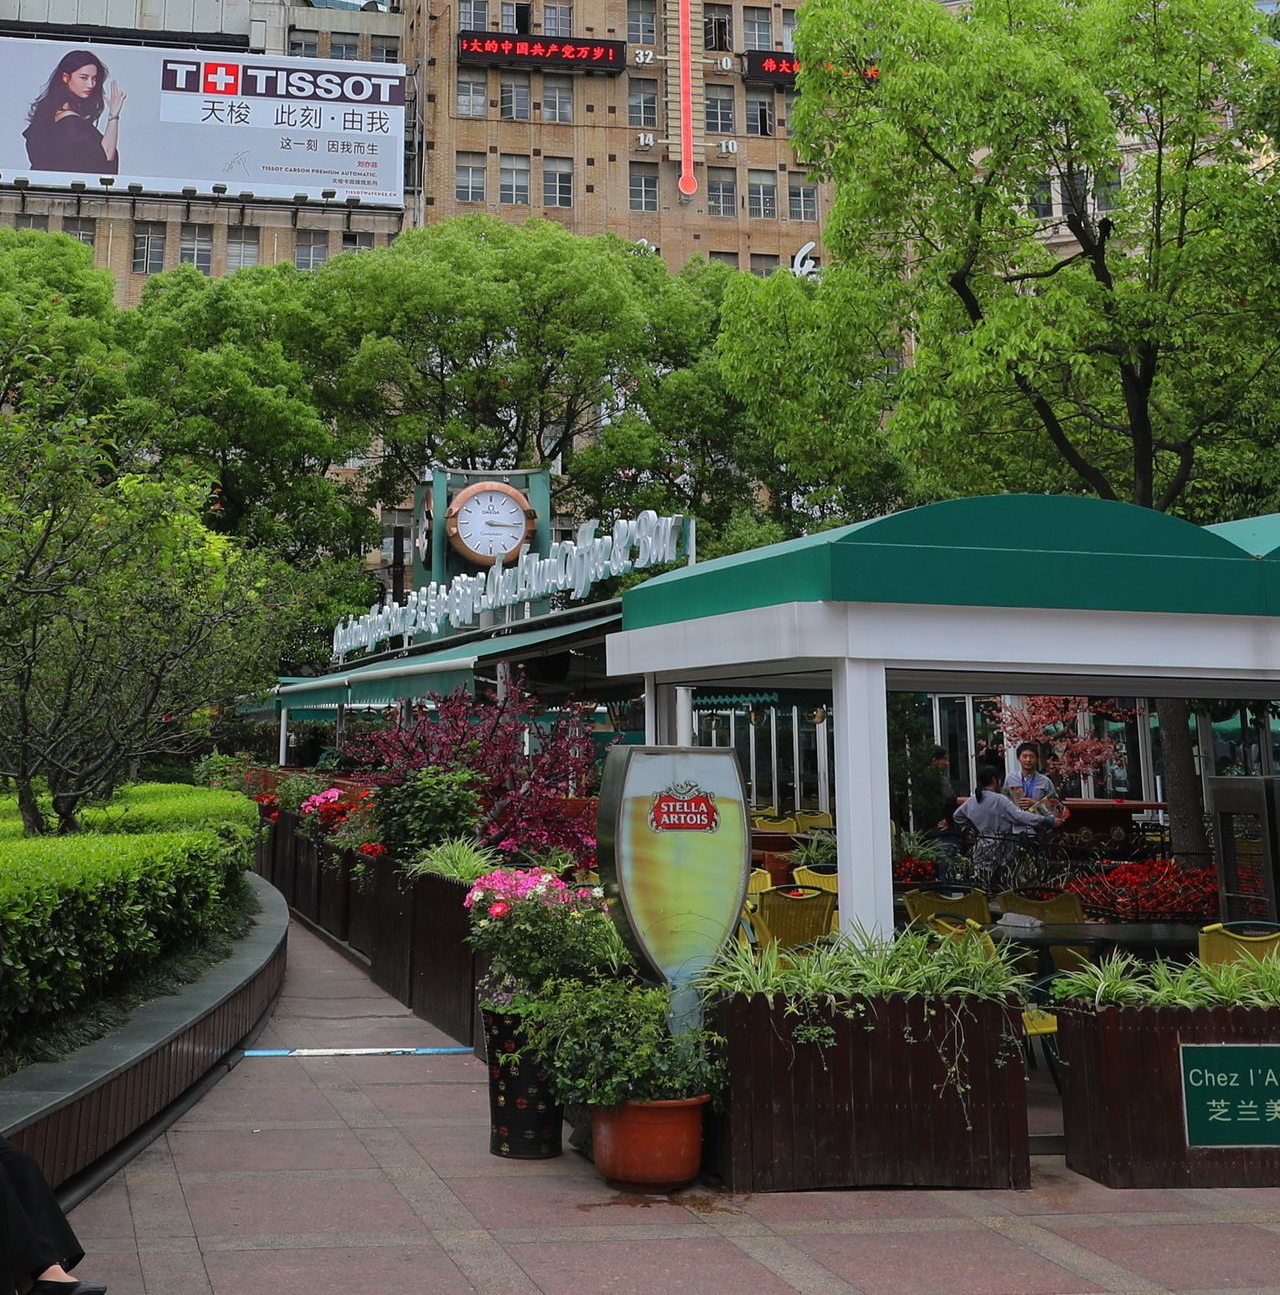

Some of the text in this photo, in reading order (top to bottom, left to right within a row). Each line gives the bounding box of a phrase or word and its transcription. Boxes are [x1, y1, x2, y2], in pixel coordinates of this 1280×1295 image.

[635, 50, 654, 64] 32
[247, 69, 400, 102] TISSOT
[201, 100, 251, 125] 天梭
[280, 137, 379, 155] 这一刻 因我而生
[637, 133, 654, 147] 14
[633, 510, 683, 569] Bar
[661, 802, 707, 812] STELLA
[661, 814, 708, 824] ARTOIS
[1189, 1069, 1240, 1087] Chez
